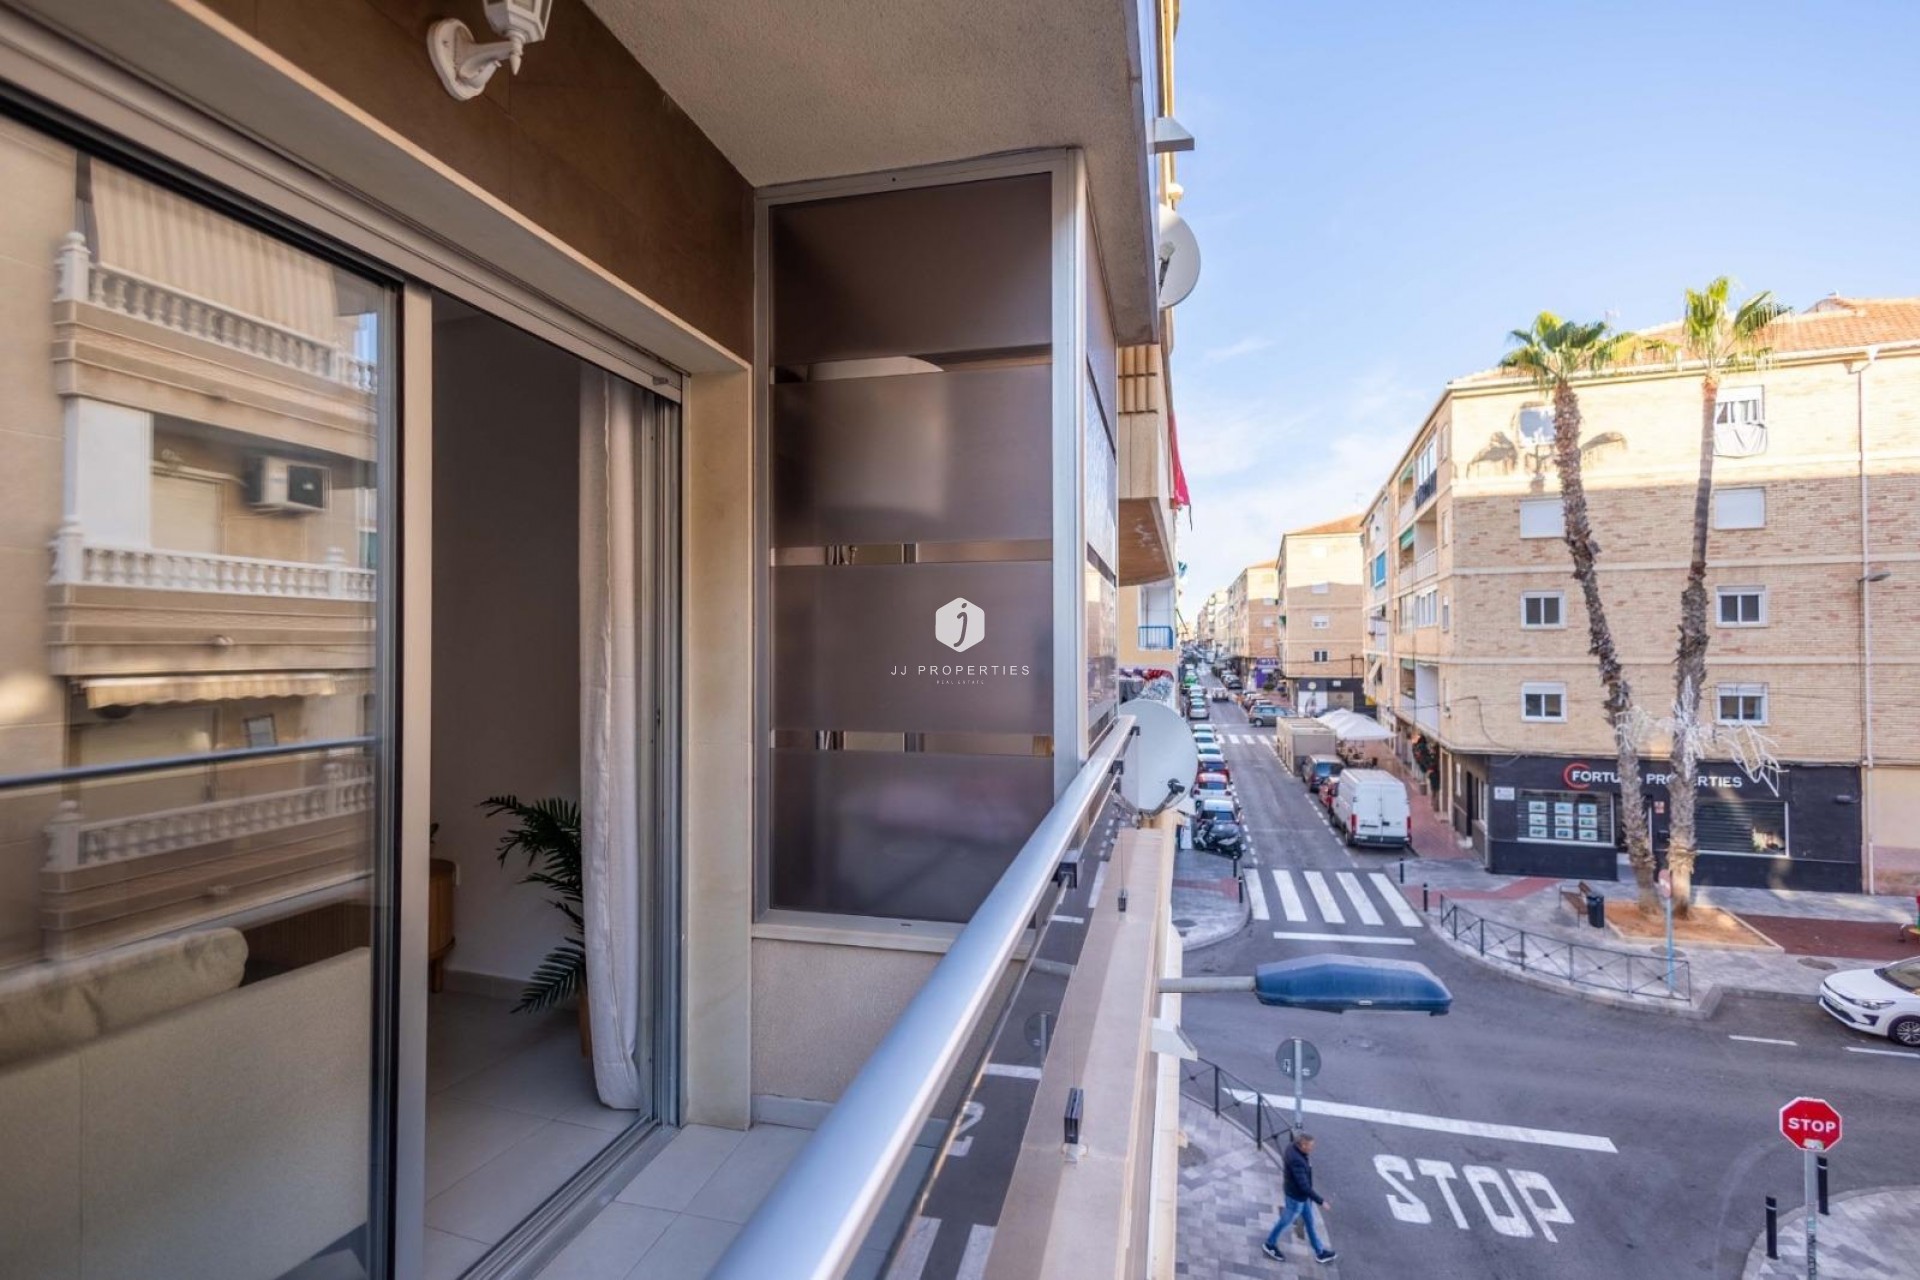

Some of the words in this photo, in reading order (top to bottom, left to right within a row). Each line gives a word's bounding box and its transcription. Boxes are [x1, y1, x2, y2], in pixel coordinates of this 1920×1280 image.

[1572, 770, 1642, 785] FORTU
[1788, 1117, 1837, 1133] STOP
[1372, 1154, 1576, 1244] STOP
